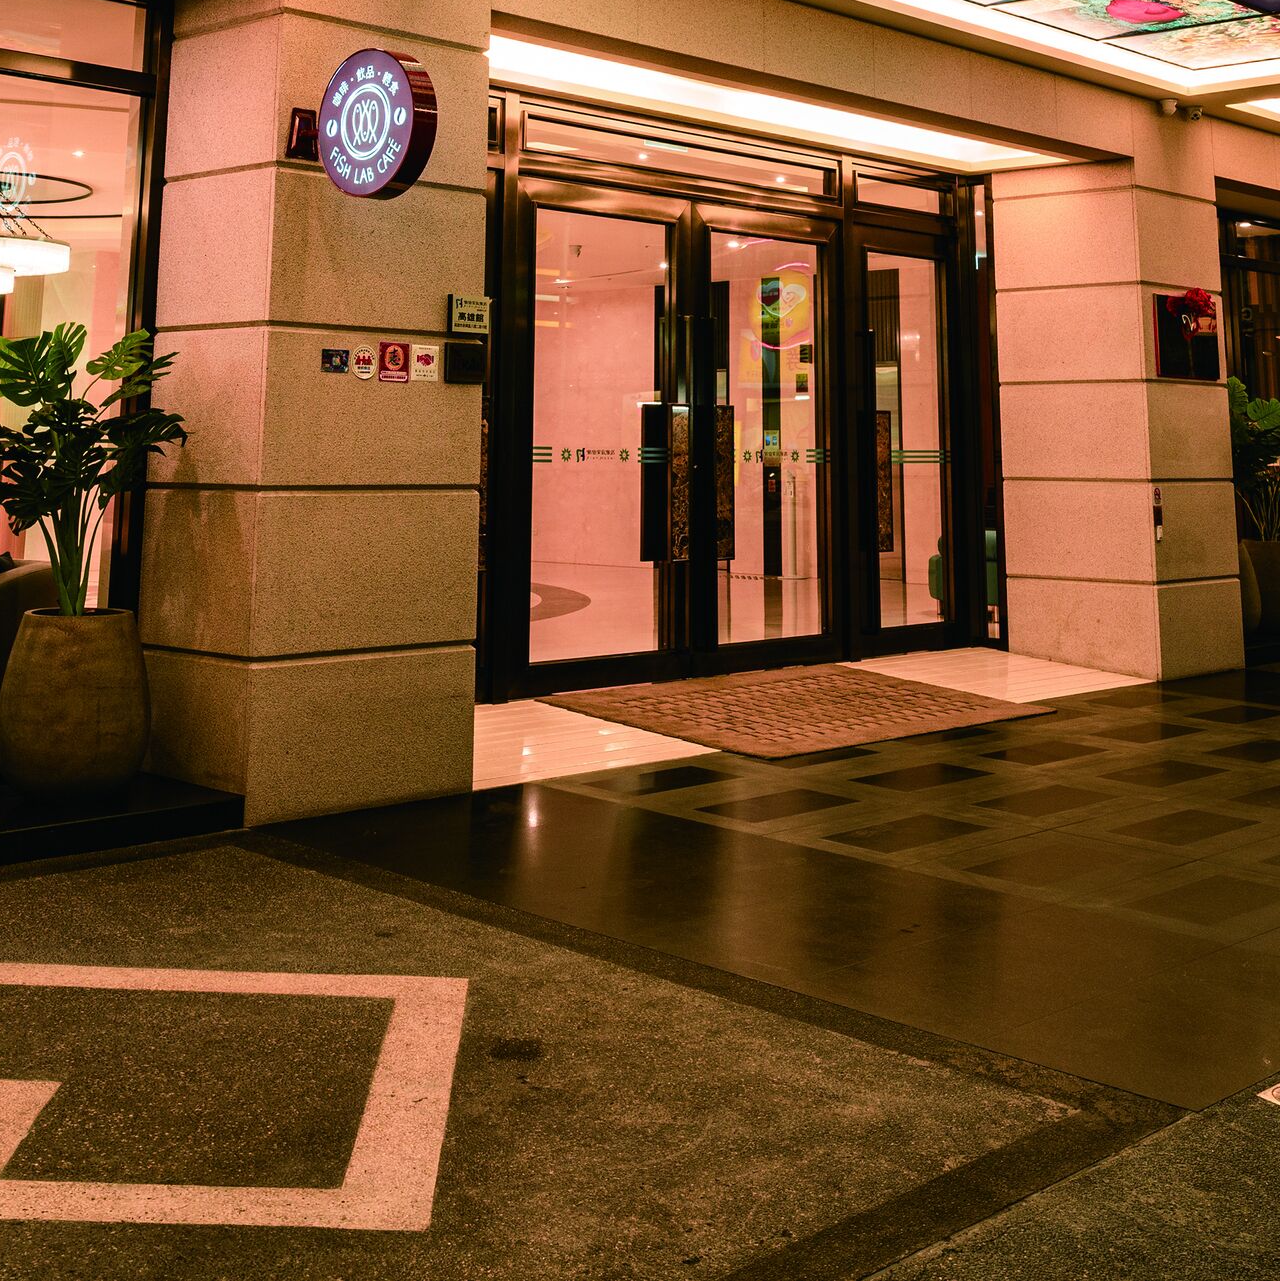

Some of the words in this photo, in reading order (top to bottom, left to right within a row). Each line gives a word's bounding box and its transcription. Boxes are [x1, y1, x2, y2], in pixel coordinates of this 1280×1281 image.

[329, 146, 352, 180] FISH
[353, 167, 375, 185] LAB
[457, 312, 484, 322] 高雄館
